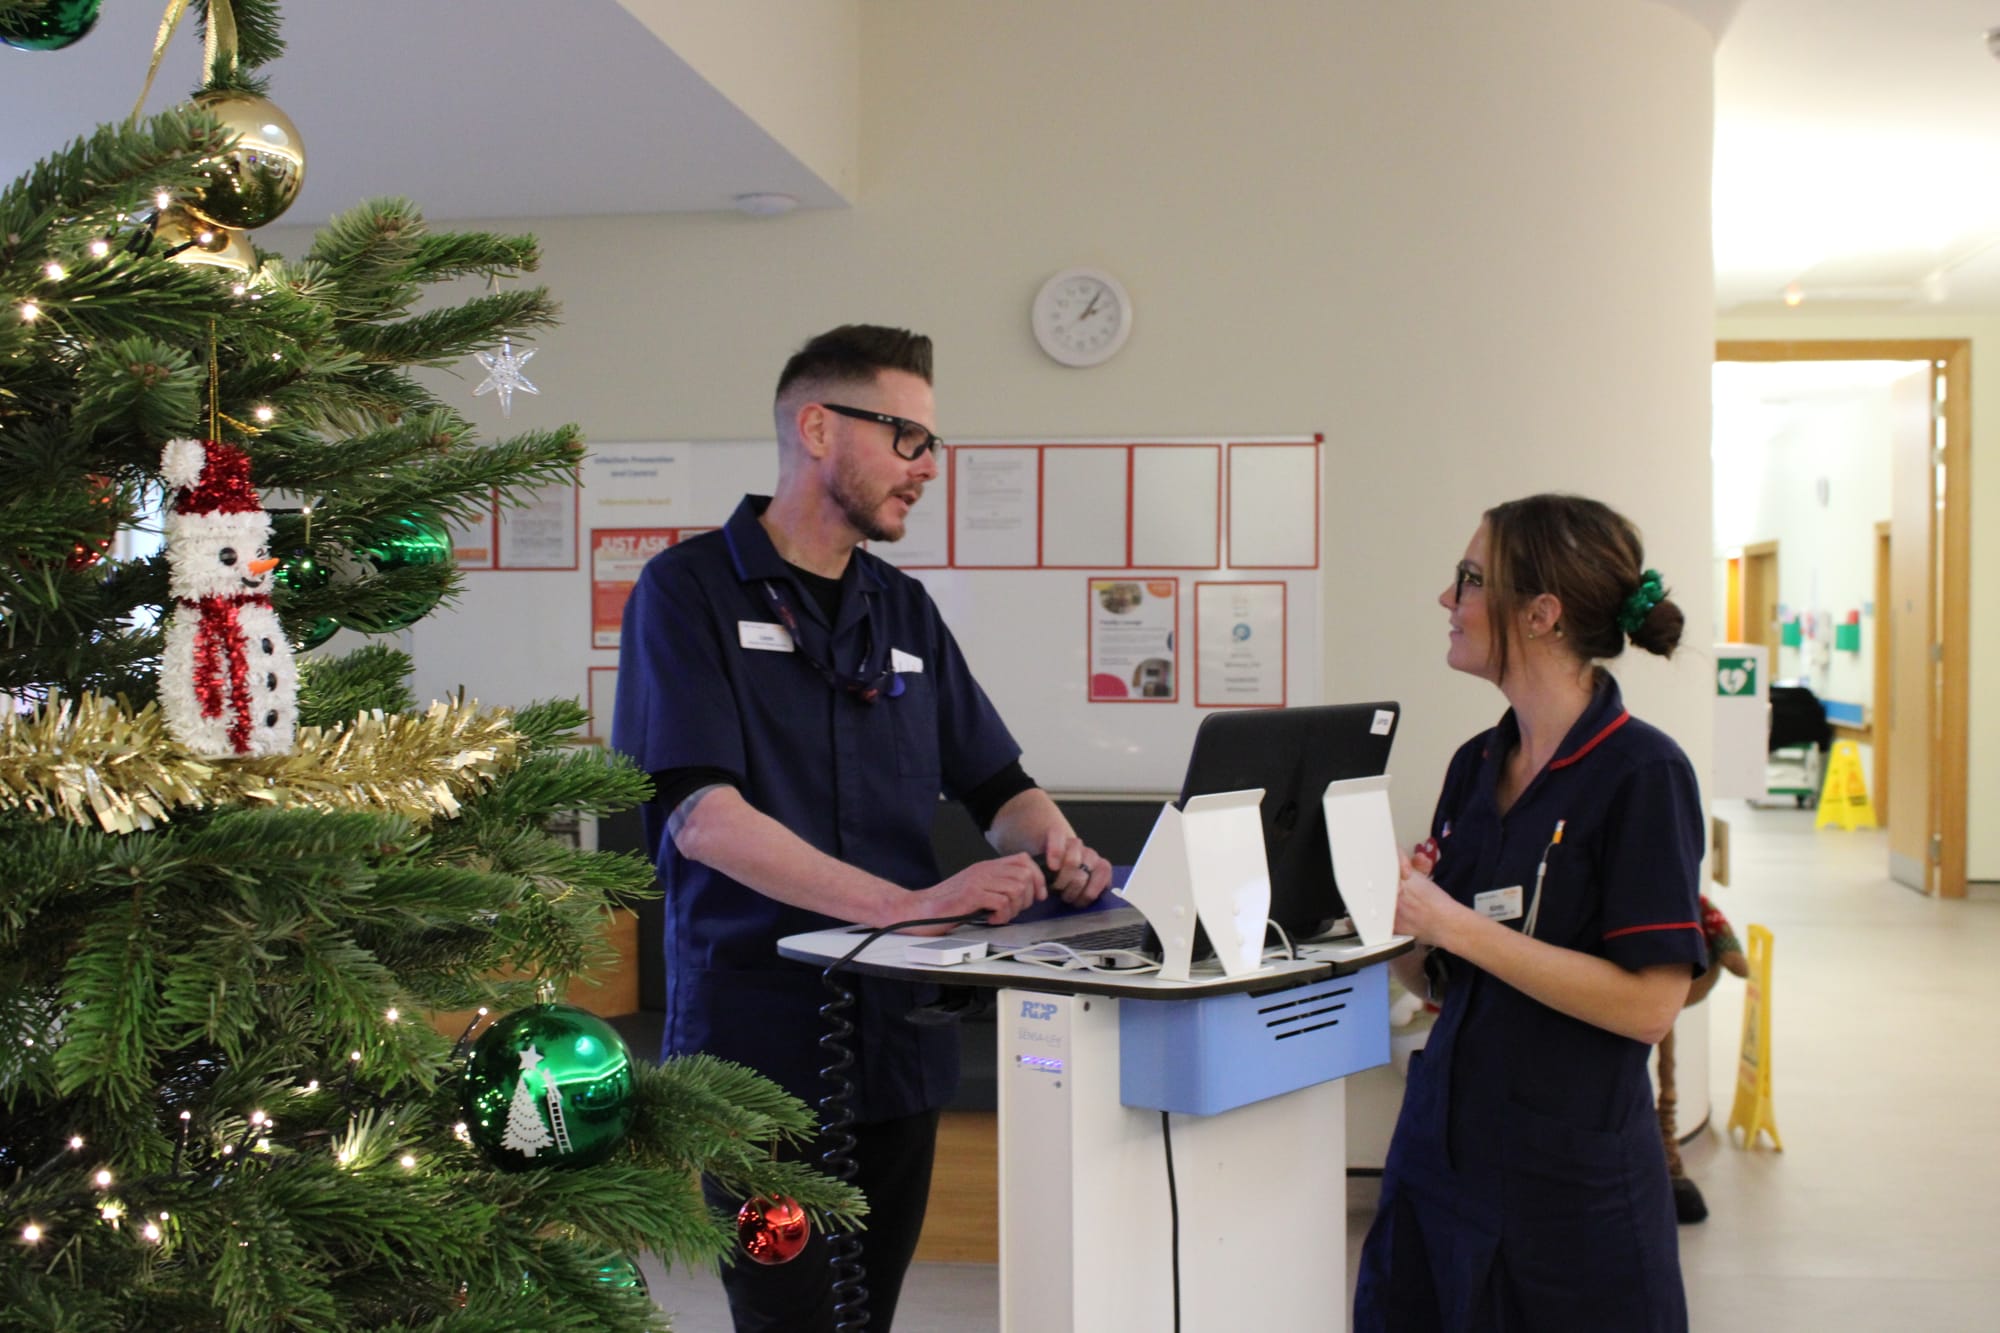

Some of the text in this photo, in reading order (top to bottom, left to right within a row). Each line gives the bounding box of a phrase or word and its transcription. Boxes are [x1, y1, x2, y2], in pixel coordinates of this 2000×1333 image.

[599, 536, 670, 552] JUST ASK
[1020, 1001, 1058, 1021] RDP
